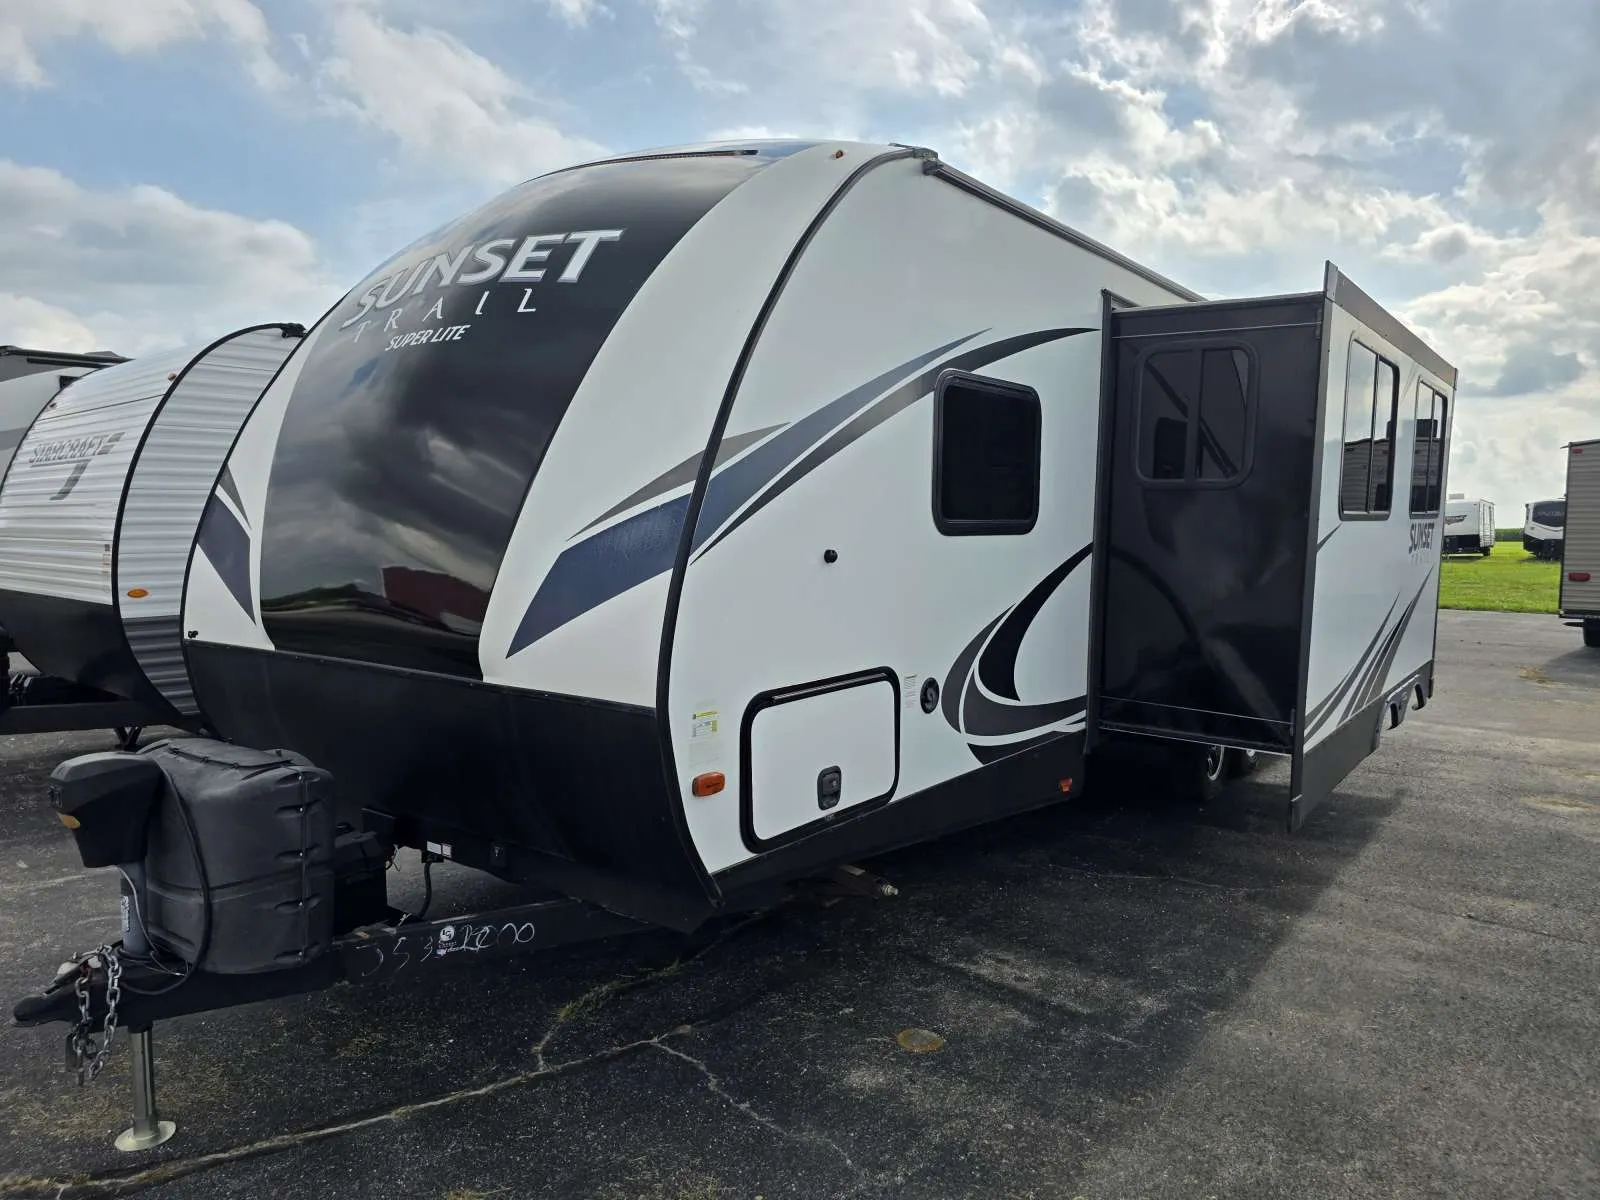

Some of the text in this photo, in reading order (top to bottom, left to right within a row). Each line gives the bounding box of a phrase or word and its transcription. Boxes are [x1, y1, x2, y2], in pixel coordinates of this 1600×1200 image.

[340, 228, 626, 331] SUNSET
[353, 288, 537, 343] TRAIL
[384, 324, 472, 351] SUPER LITE
[28, 434, 111, 463] STARCRAFT
[1409, 522, 1435, 554] SUNSET
